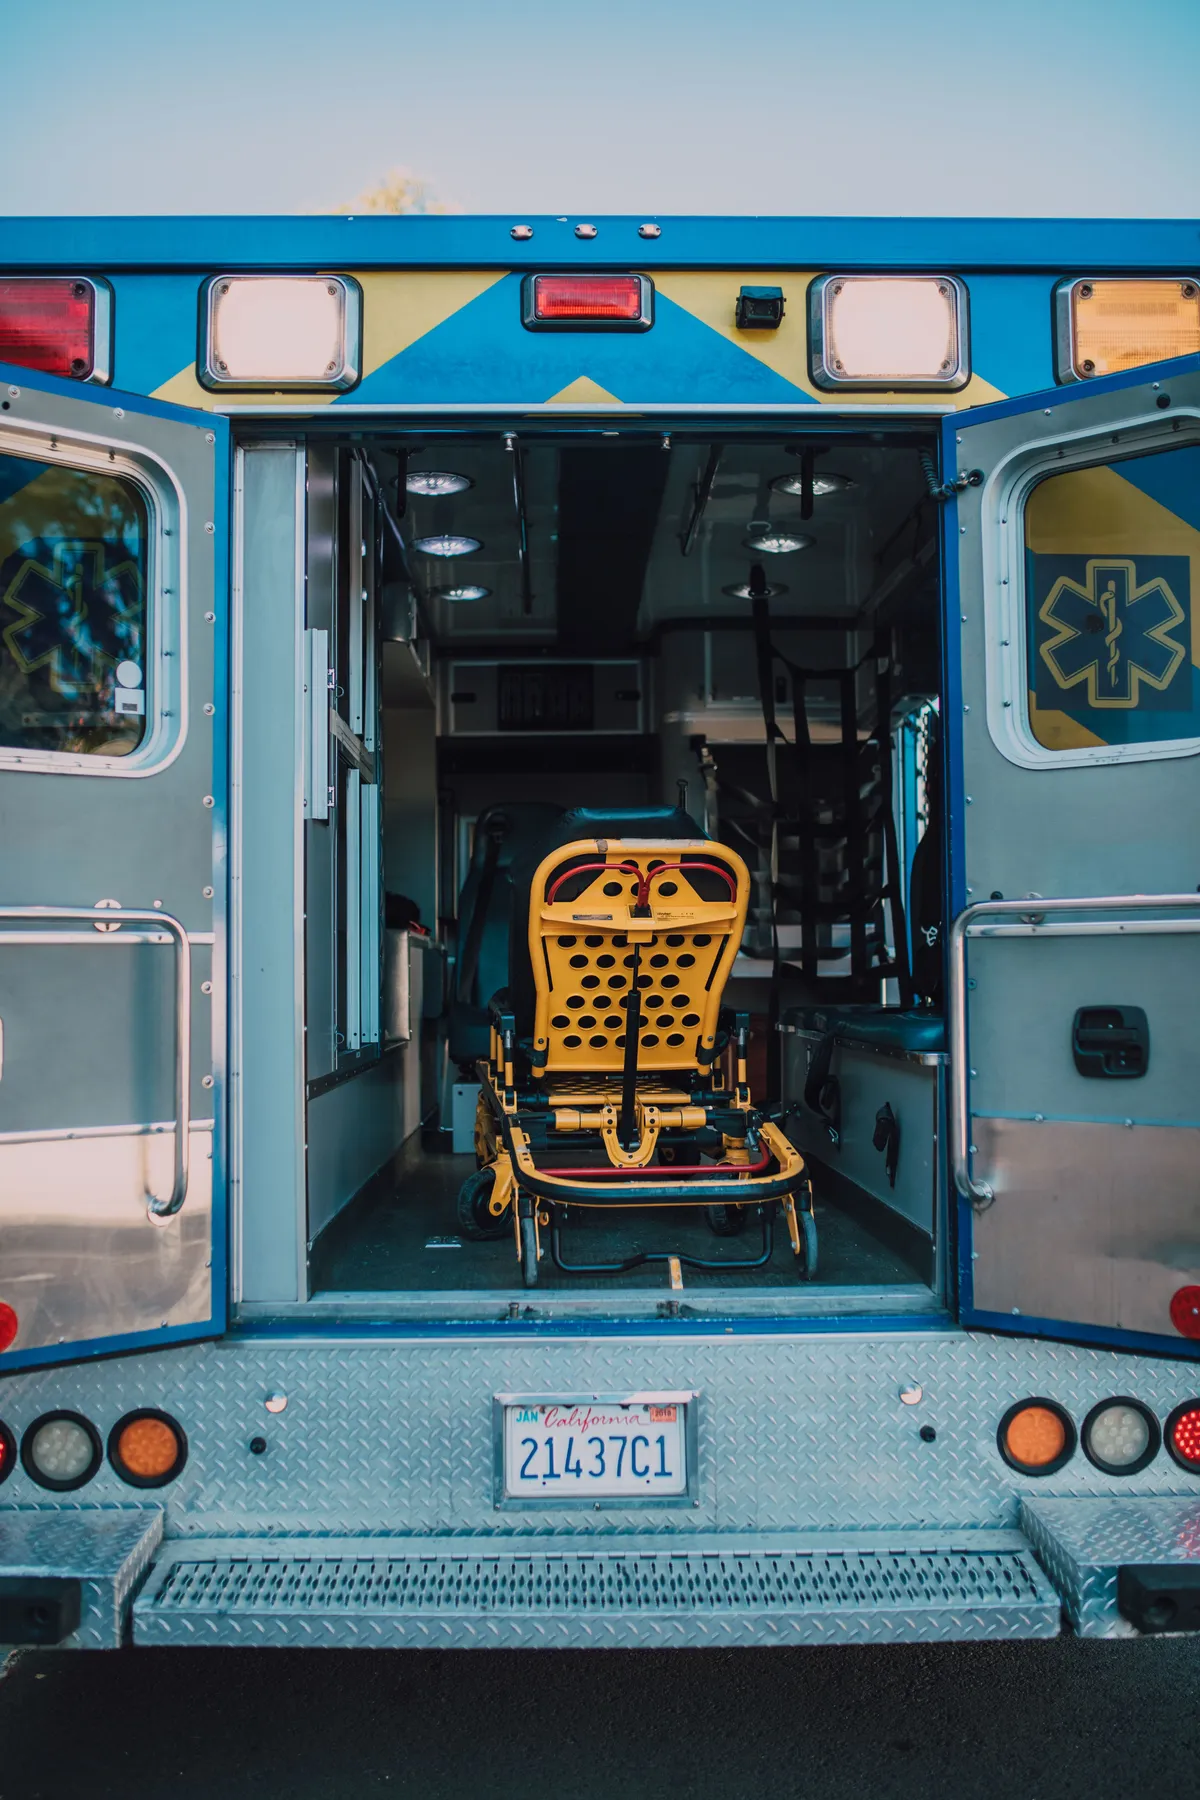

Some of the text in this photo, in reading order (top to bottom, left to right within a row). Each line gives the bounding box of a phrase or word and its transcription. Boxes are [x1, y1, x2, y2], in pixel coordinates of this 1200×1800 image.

[516, 1411, 538, 1423] JAN
[544, 1407, 650, 1433] California
[520, 1435, 673, 1479] 21437C1
